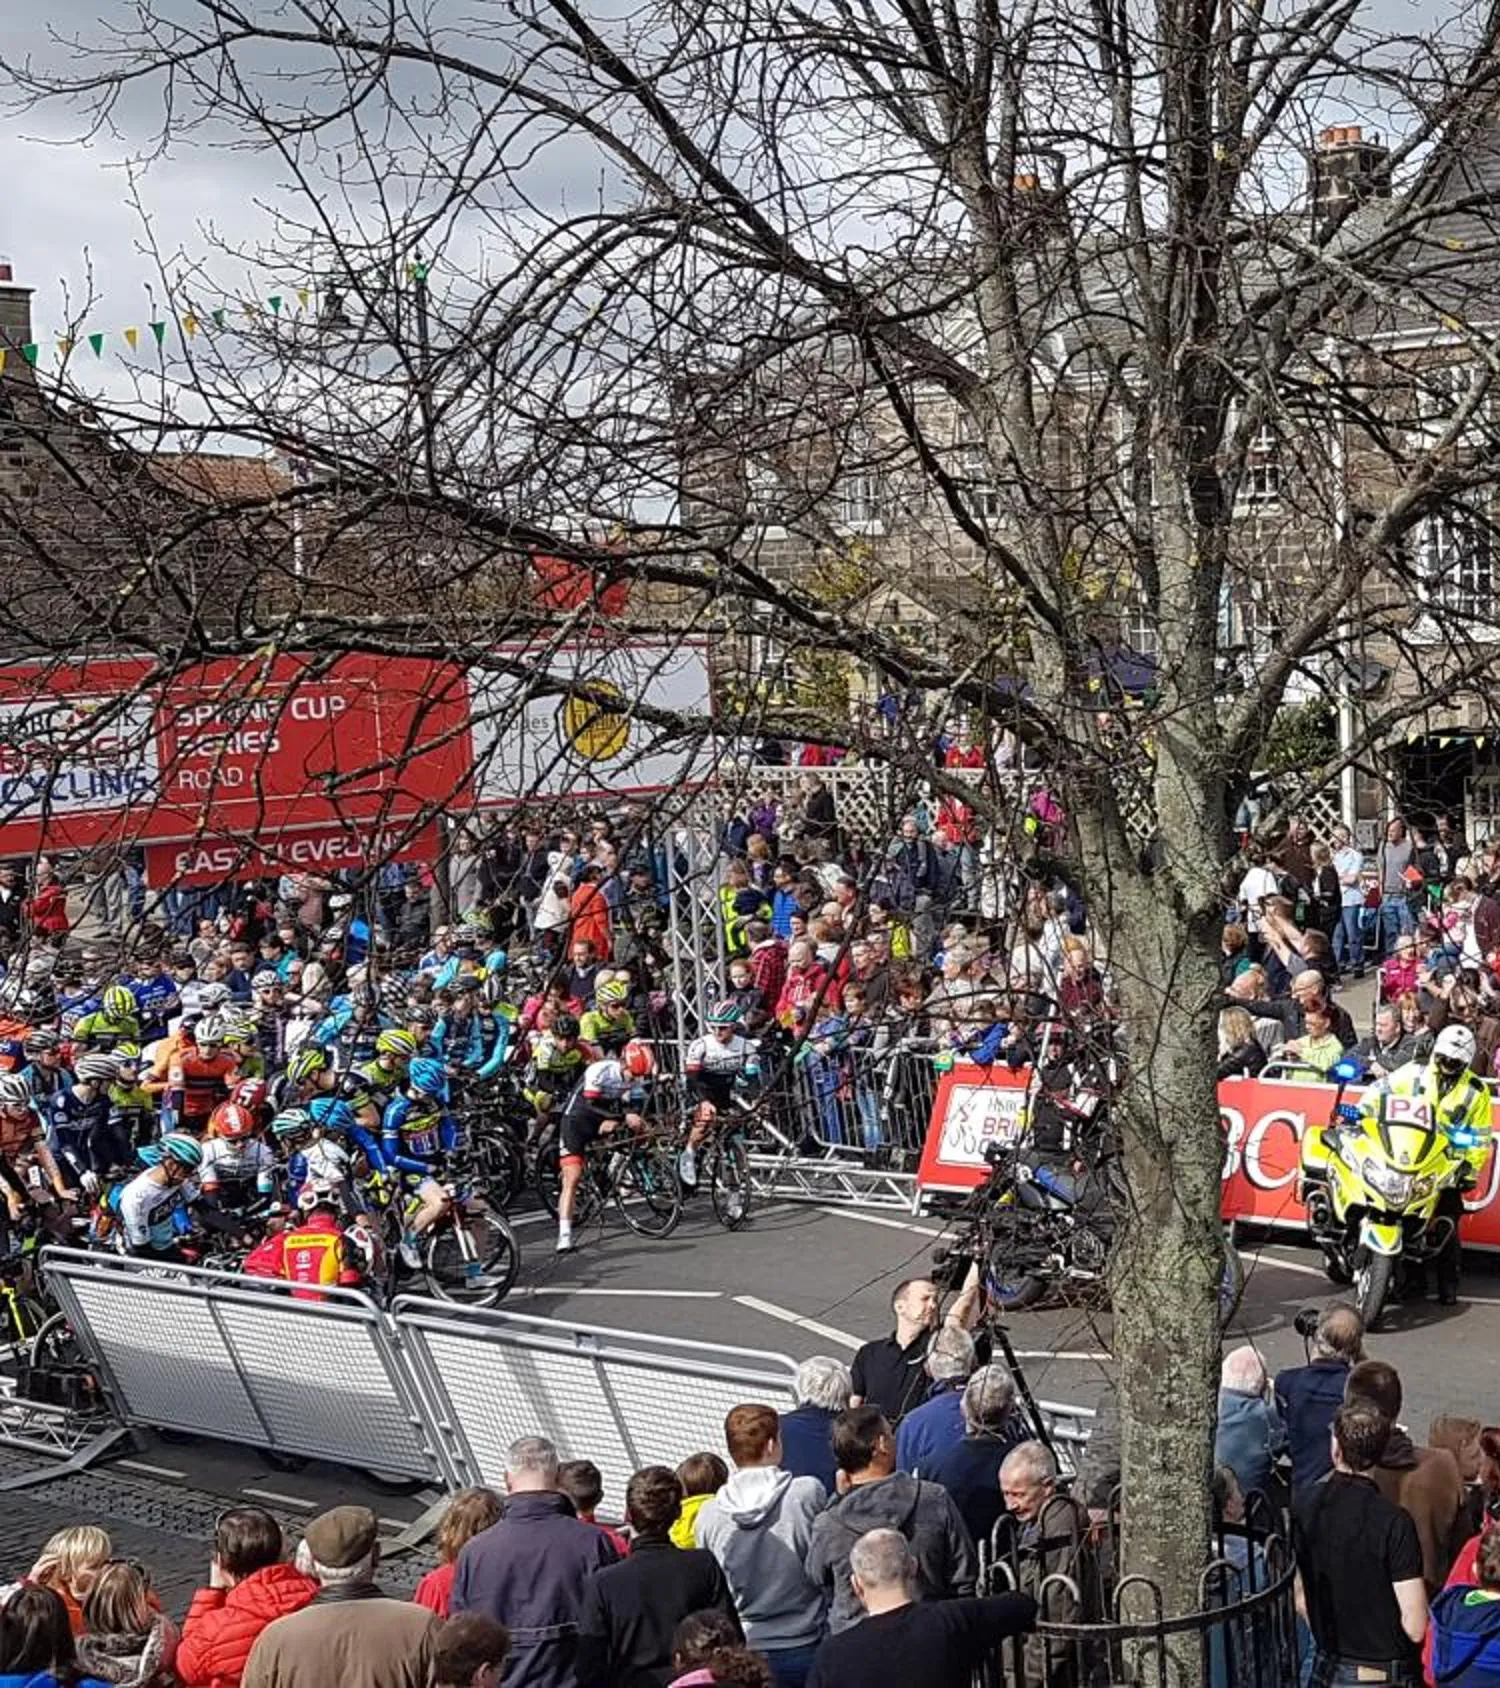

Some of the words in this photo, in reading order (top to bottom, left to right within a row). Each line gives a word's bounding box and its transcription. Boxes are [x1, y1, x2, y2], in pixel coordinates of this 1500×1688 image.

[174, 699, 280, 727] SPRNG
[291, 695, 346, 721] CUP
[178, 767, 243, 790] ROAD
[1391, 1098, 1430, 1126] P4
